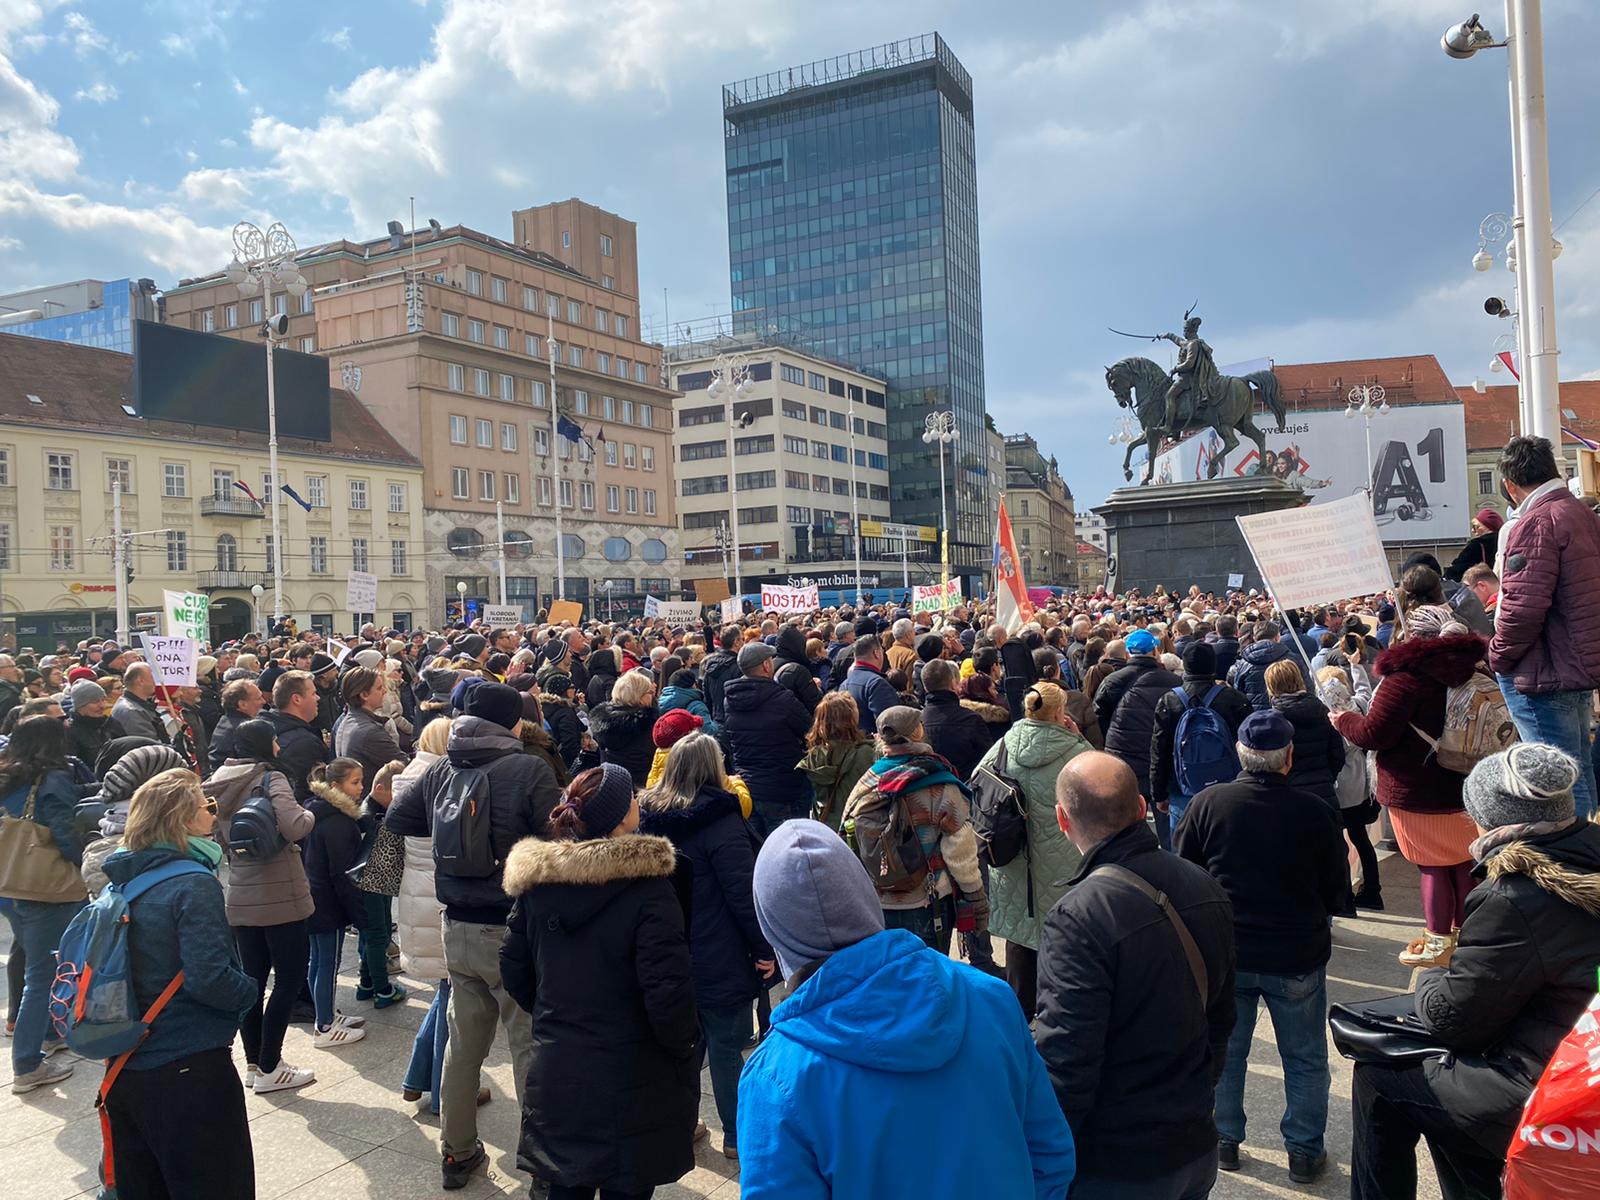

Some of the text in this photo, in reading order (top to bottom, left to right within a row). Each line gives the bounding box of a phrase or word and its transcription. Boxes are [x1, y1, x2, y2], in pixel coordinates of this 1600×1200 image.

[1260, 422, 1309, 436] oveuješ
[1373, 427, 1446, 515] A1
[787, 575, 814, 587] Špia
[920, 582, 957, 599] SLOBDA
[1520, 1124, 1600, 1155] KON
